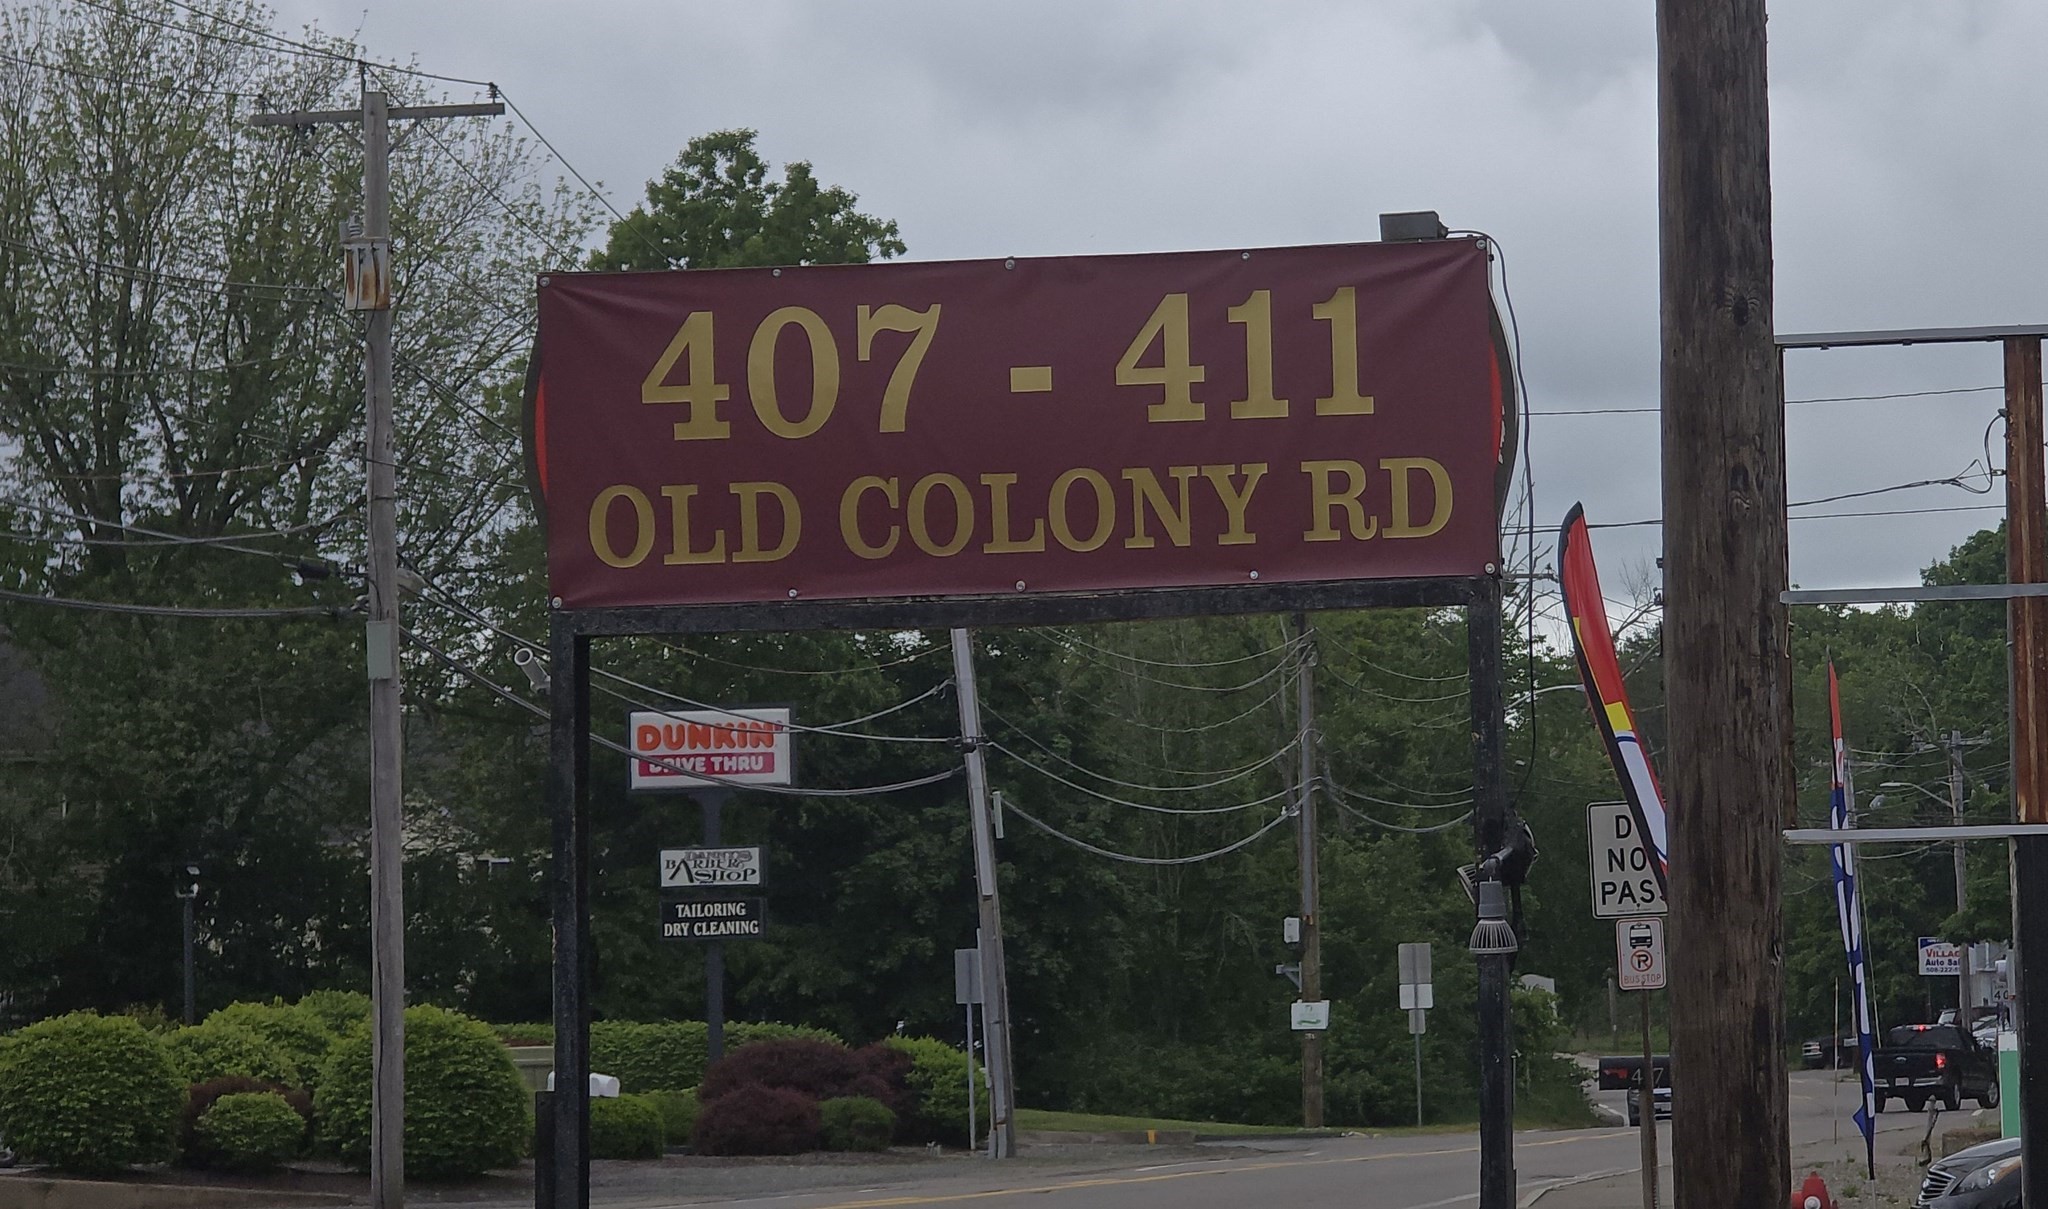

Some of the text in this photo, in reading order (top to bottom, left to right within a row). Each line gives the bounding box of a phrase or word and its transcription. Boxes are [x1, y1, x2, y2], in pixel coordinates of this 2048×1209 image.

[641, 286, 1375, 442] 407 - 411
[588, 456, 1455, 569] OLD COLONY RD
[710, 755, 764, 771] THRU
[1615, 815, 1632, 839] D
[1608, 847, 1647, 872] NO
[665, 858, 744, 883] BARBER
[694, 868, 757, 882] SHOP
[1601, 879, 1664, 905] PAS
[675, 902, 747, 918] TAILORING
[663, 920, 759, 937] DRY CLEANING
[1925, 949, 1960, 958] VILLA
[1925, 958, 1961, 966] Auto Sal
[1623, 974, 1662, 984] BUS STOP
